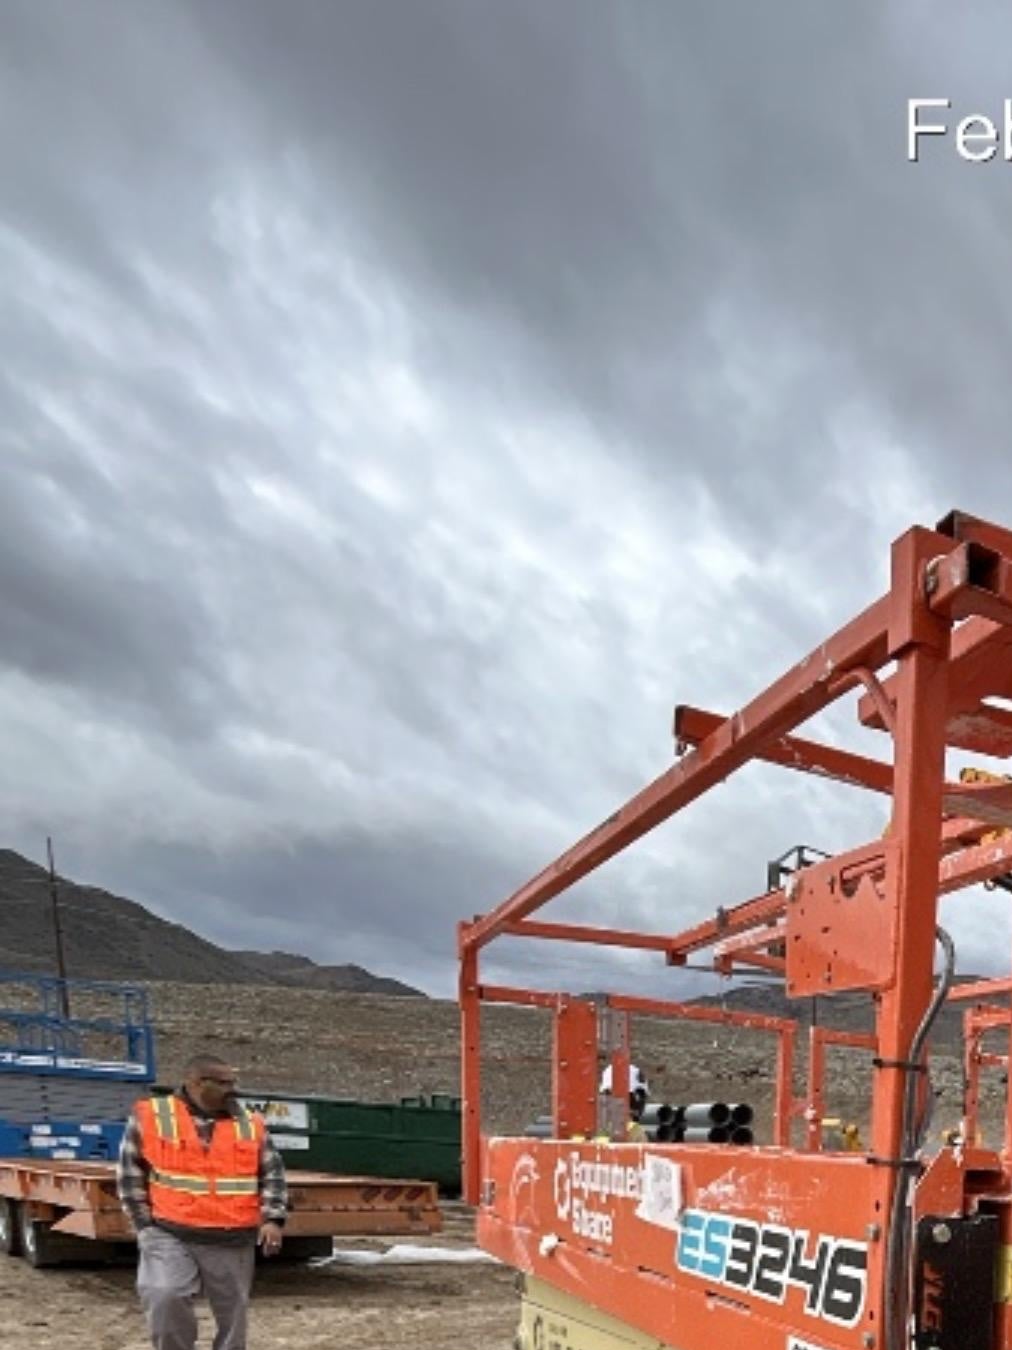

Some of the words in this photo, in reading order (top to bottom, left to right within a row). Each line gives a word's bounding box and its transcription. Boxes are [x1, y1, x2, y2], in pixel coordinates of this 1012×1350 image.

[570, 1151, 642, 1204] Equipme
[571, 1196, 614, 1245] Share
[676, 1209, 872, 1329] ES3246
